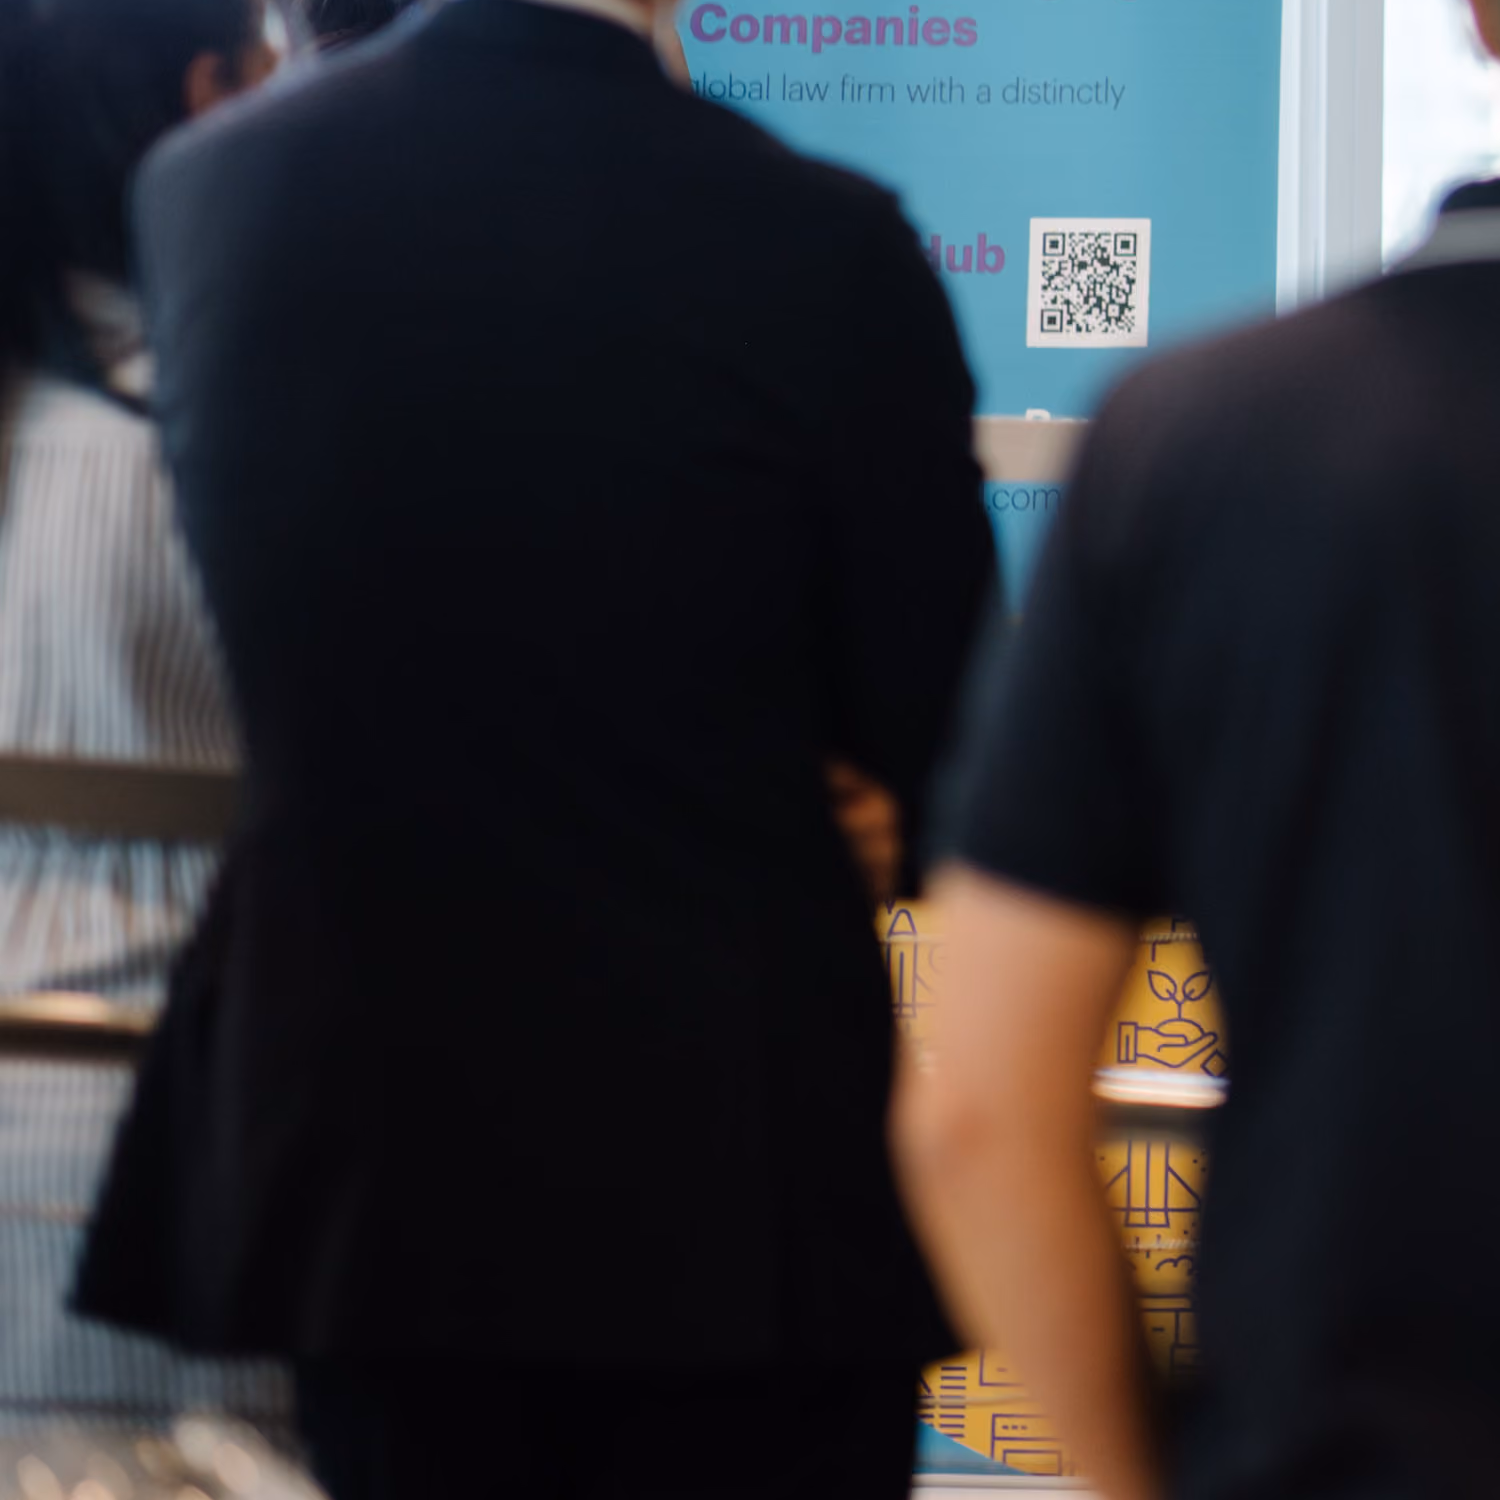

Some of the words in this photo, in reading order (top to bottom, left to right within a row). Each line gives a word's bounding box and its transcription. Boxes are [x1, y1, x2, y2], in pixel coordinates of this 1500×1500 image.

[690, 2, 979, 55] Companies
[781, 73, 828, 103] law
[840, 72, 896, 104] firm
[906, 75, 965, 105] with
[976, 84, 992, 105] a
[1001, 75, 1127, 111] distinctly
